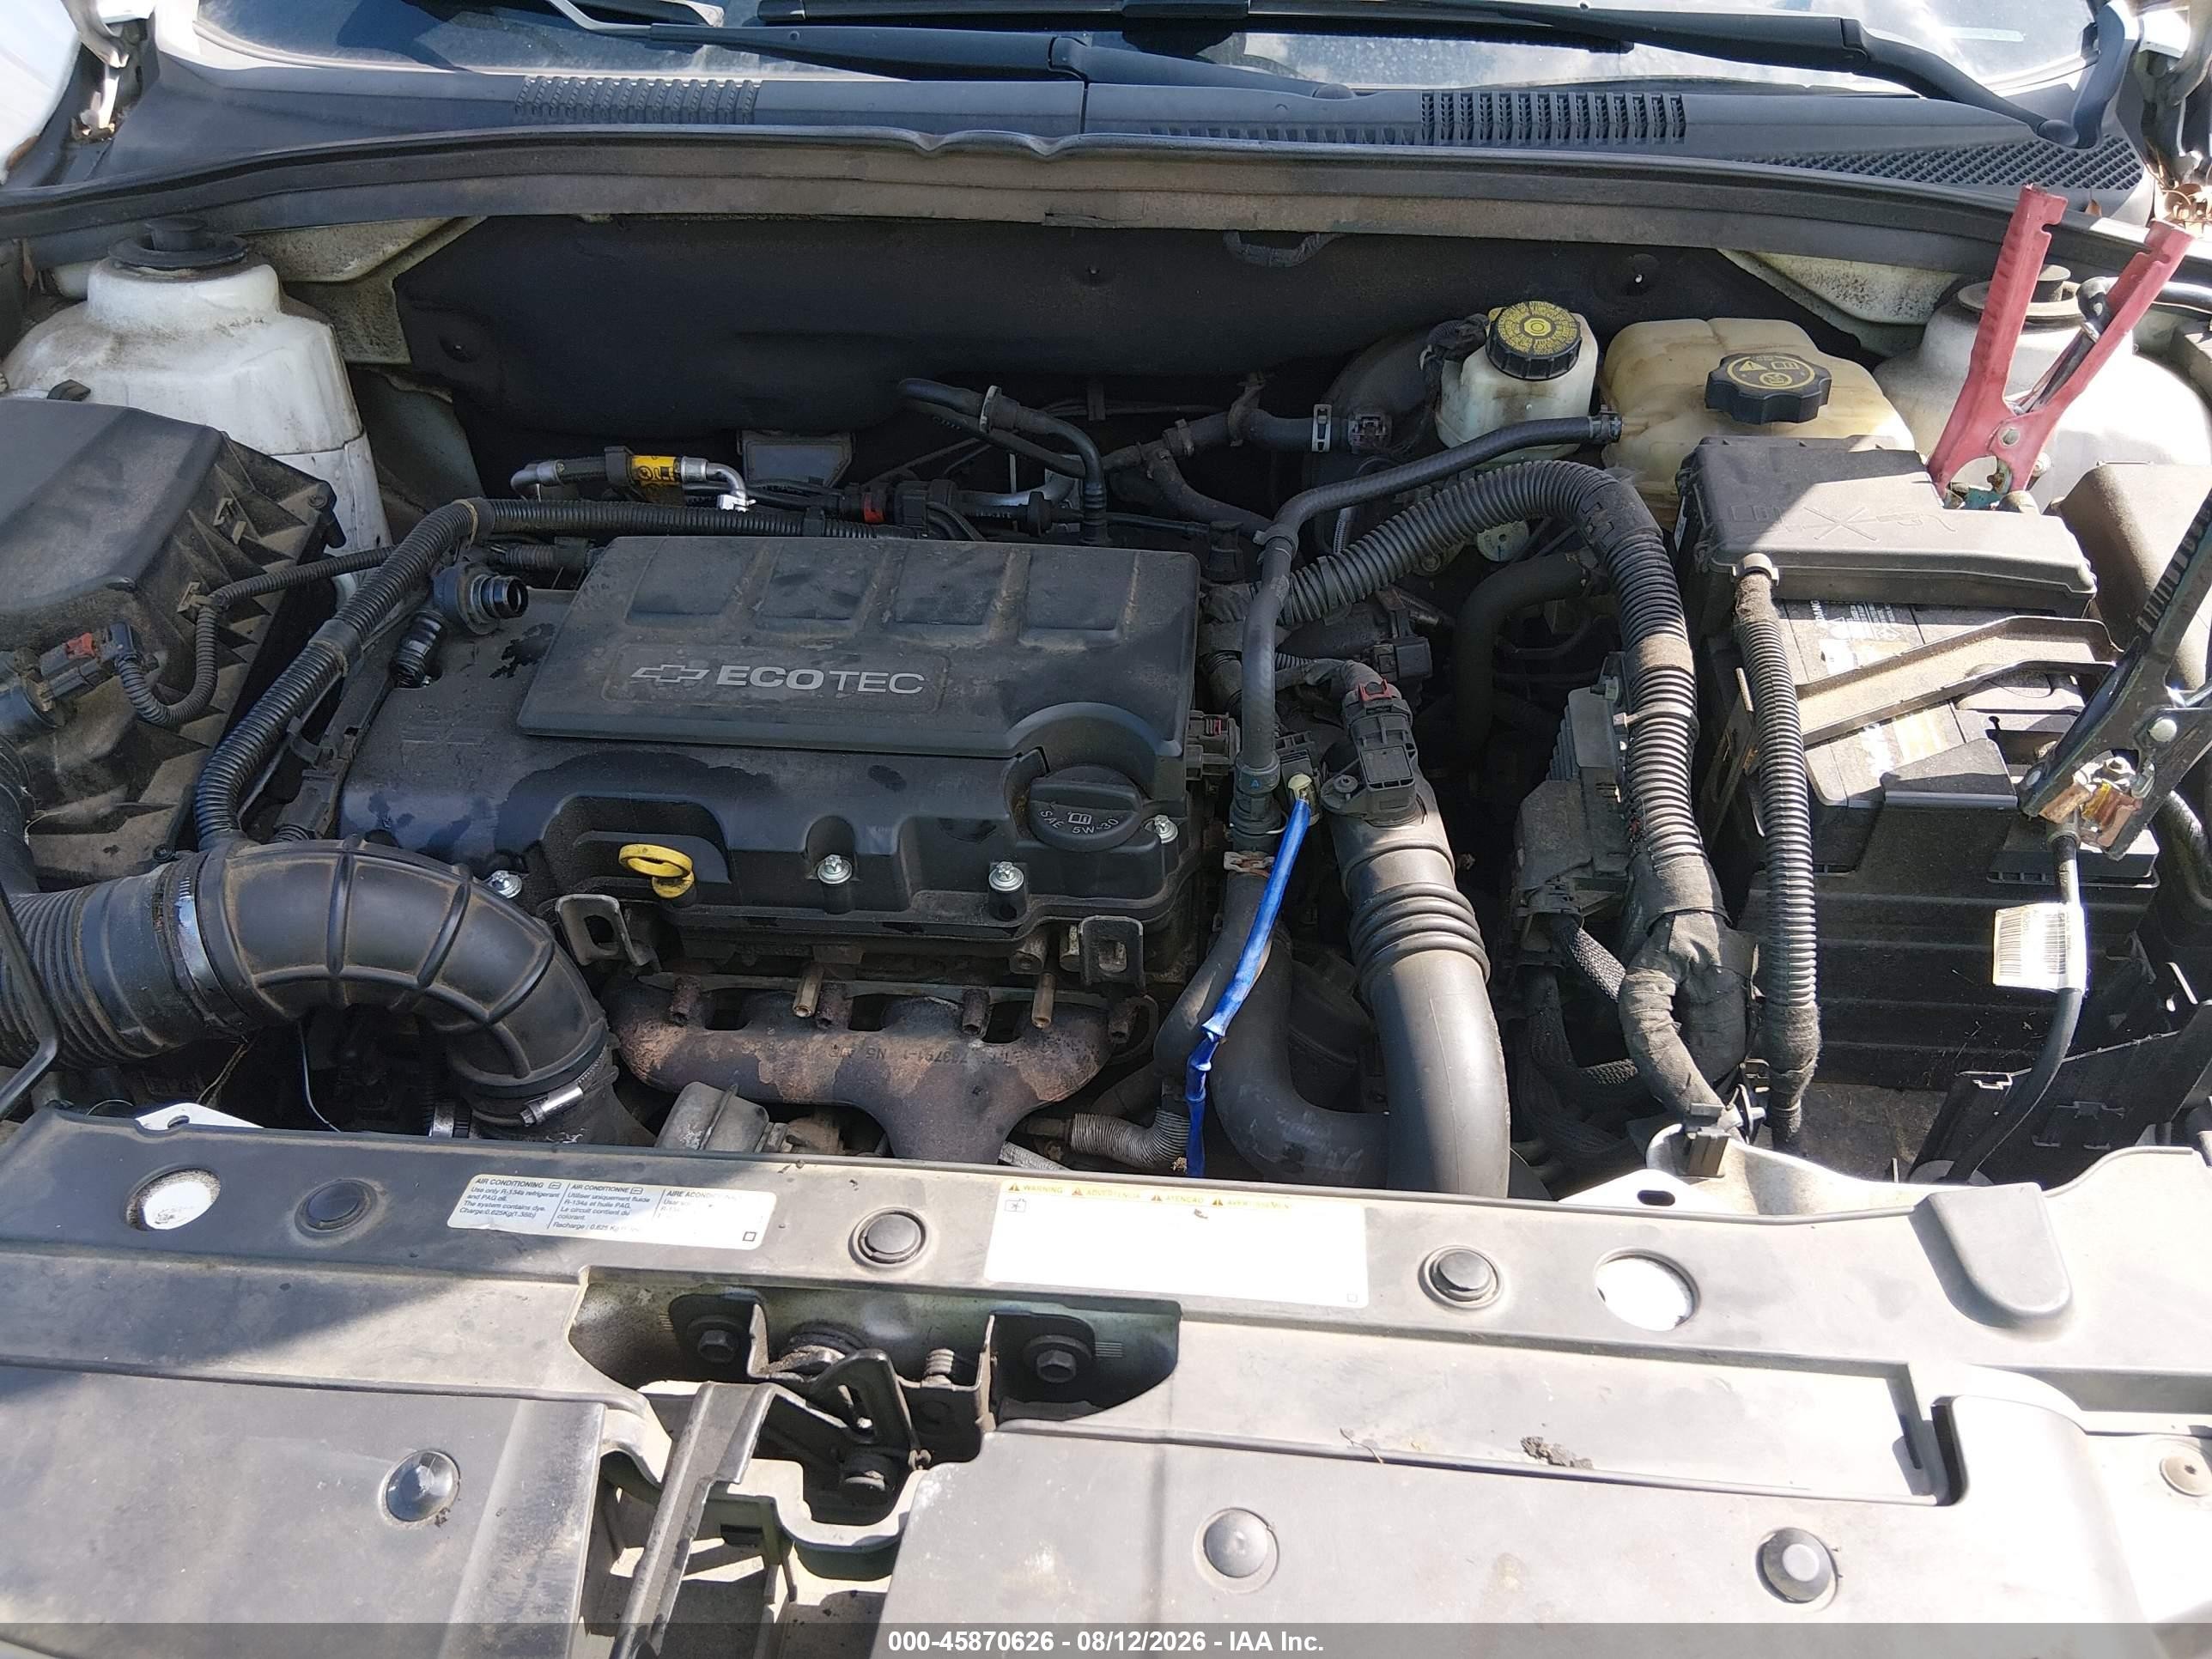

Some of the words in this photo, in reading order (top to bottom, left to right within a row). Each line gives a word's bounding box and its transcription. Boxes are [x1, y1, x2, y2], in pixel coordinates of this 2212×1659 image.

[716, 664, 925, 694] ECOTEC
[1040, 810, 1065, 829] SAE
[1072, 818, 1119, 834] 5W-30
[489, 1179, 544, 1188] CONDITIONING
[592, 1194, 631, 1202] uniquement
[553, 1222, 586, 1231] Recharge
